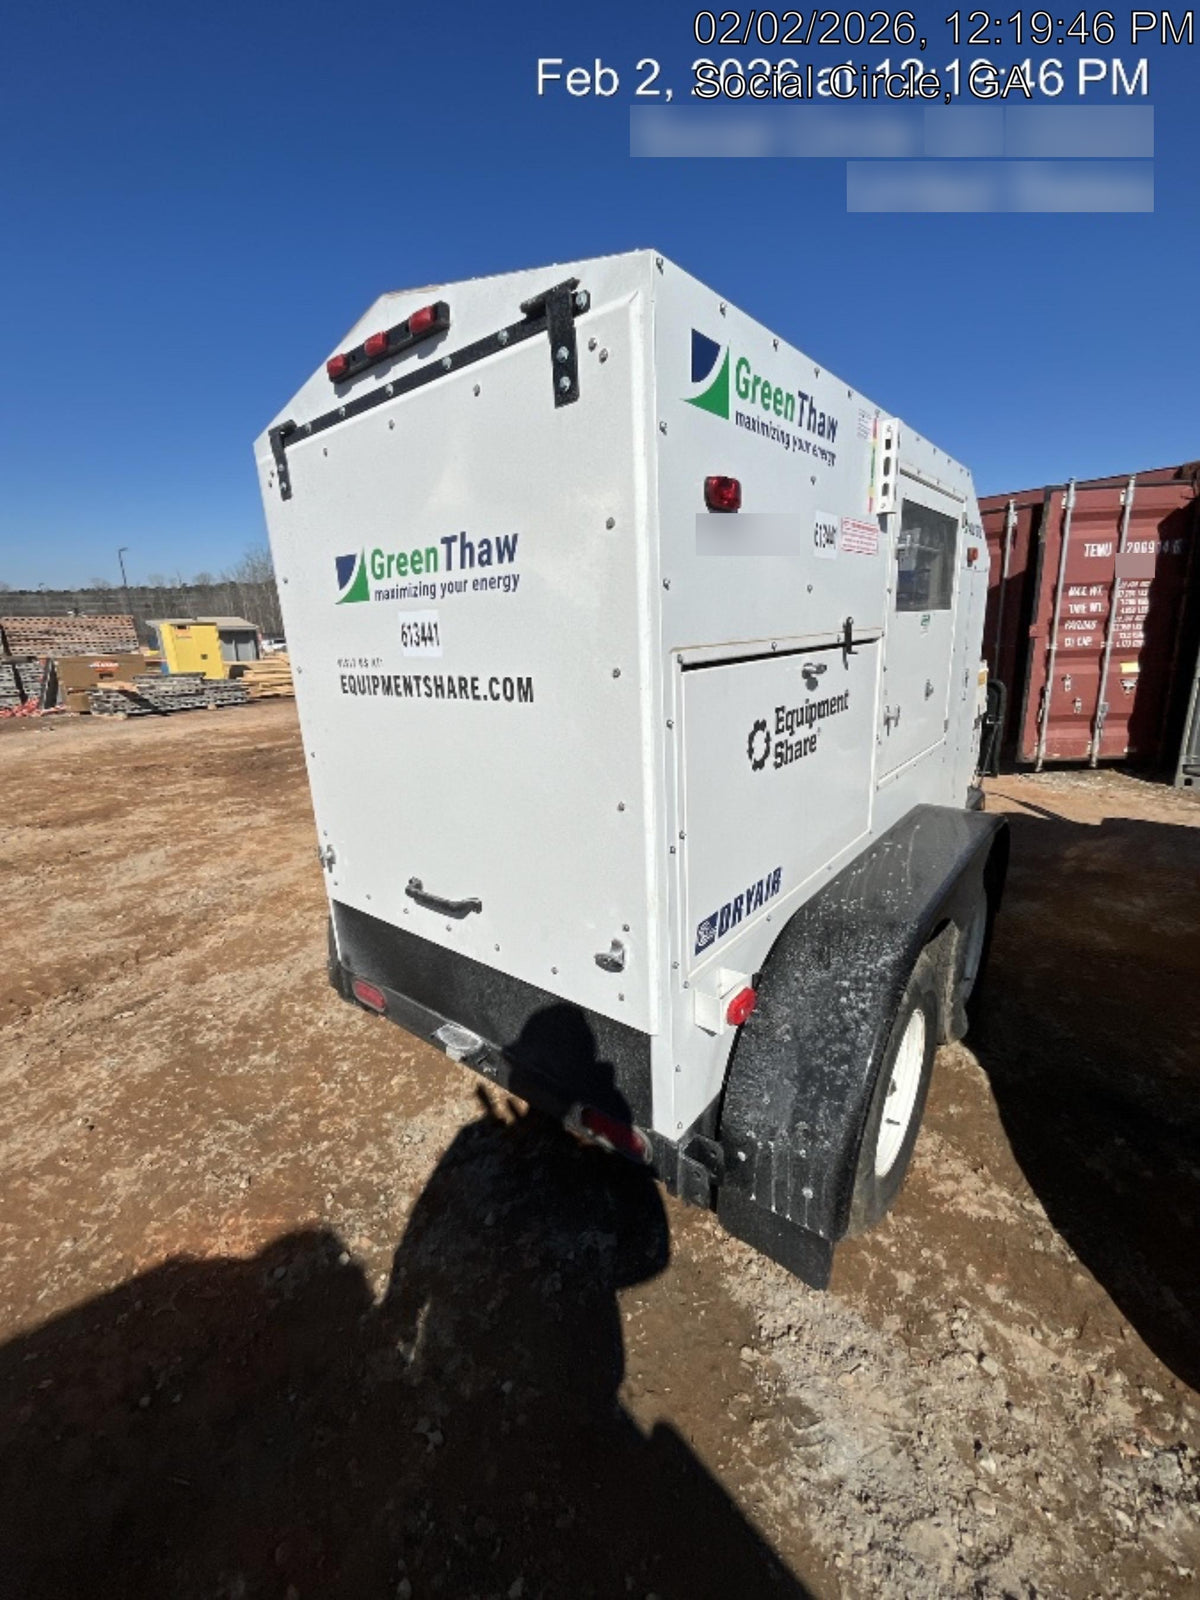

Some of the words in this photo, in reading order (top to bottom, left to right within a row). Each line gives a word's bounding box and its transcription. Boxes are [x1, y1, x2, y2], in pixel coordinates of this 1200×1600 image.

[735, 356, 838, 443] GreenThaw
[735, 410, 791, 450] maximizing
[370, 531, 518, 580] GreenThaw
[1084, 542, 1112, 558] TEMU
[374, 580, 436, 602] maximizing
[440, 579, 469, 599] your
[472, 573, 520, 593] energy
[401, 621, 440, 648] 613441
[340, 674, 534, 703] EQUIPMENTSHARE.COM
[775, 689, 849, 737] Equipment
[773, 733, 818, 770] Share
[717, 866, 783, 939] DRYAIR
